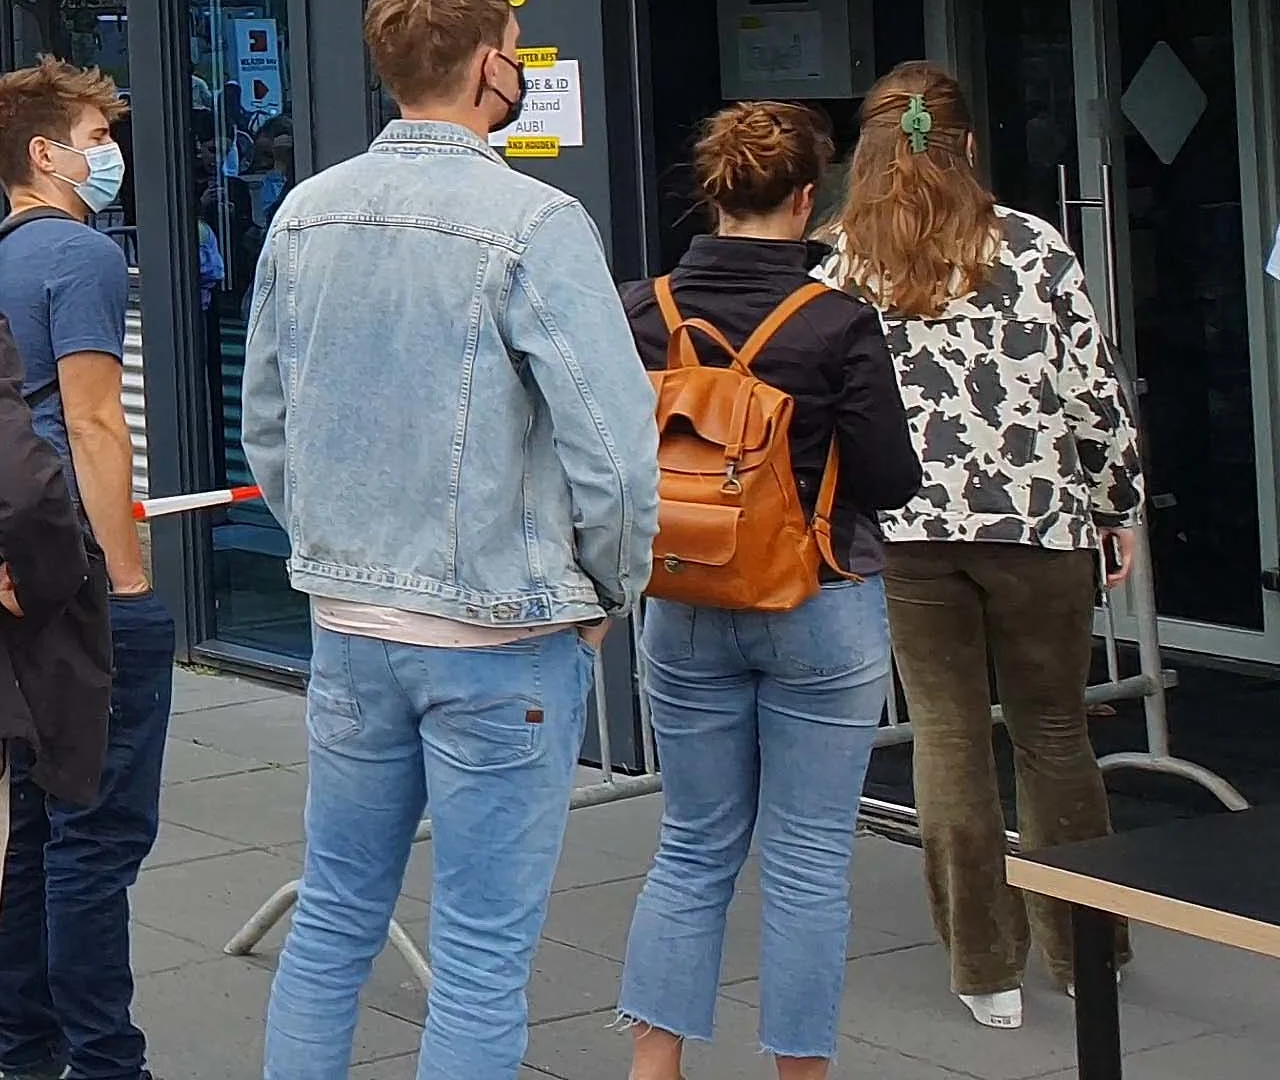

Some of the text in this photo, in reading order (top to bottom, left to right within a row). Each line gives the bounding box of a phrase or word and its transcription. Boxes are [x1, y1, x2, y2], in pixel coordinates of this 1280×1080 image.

[544, 79, 553, 89] &
[556, 79, 568, 89] ID
[532, 99, 560, 111] hand
[515, 121, 544, 133] AUB!
